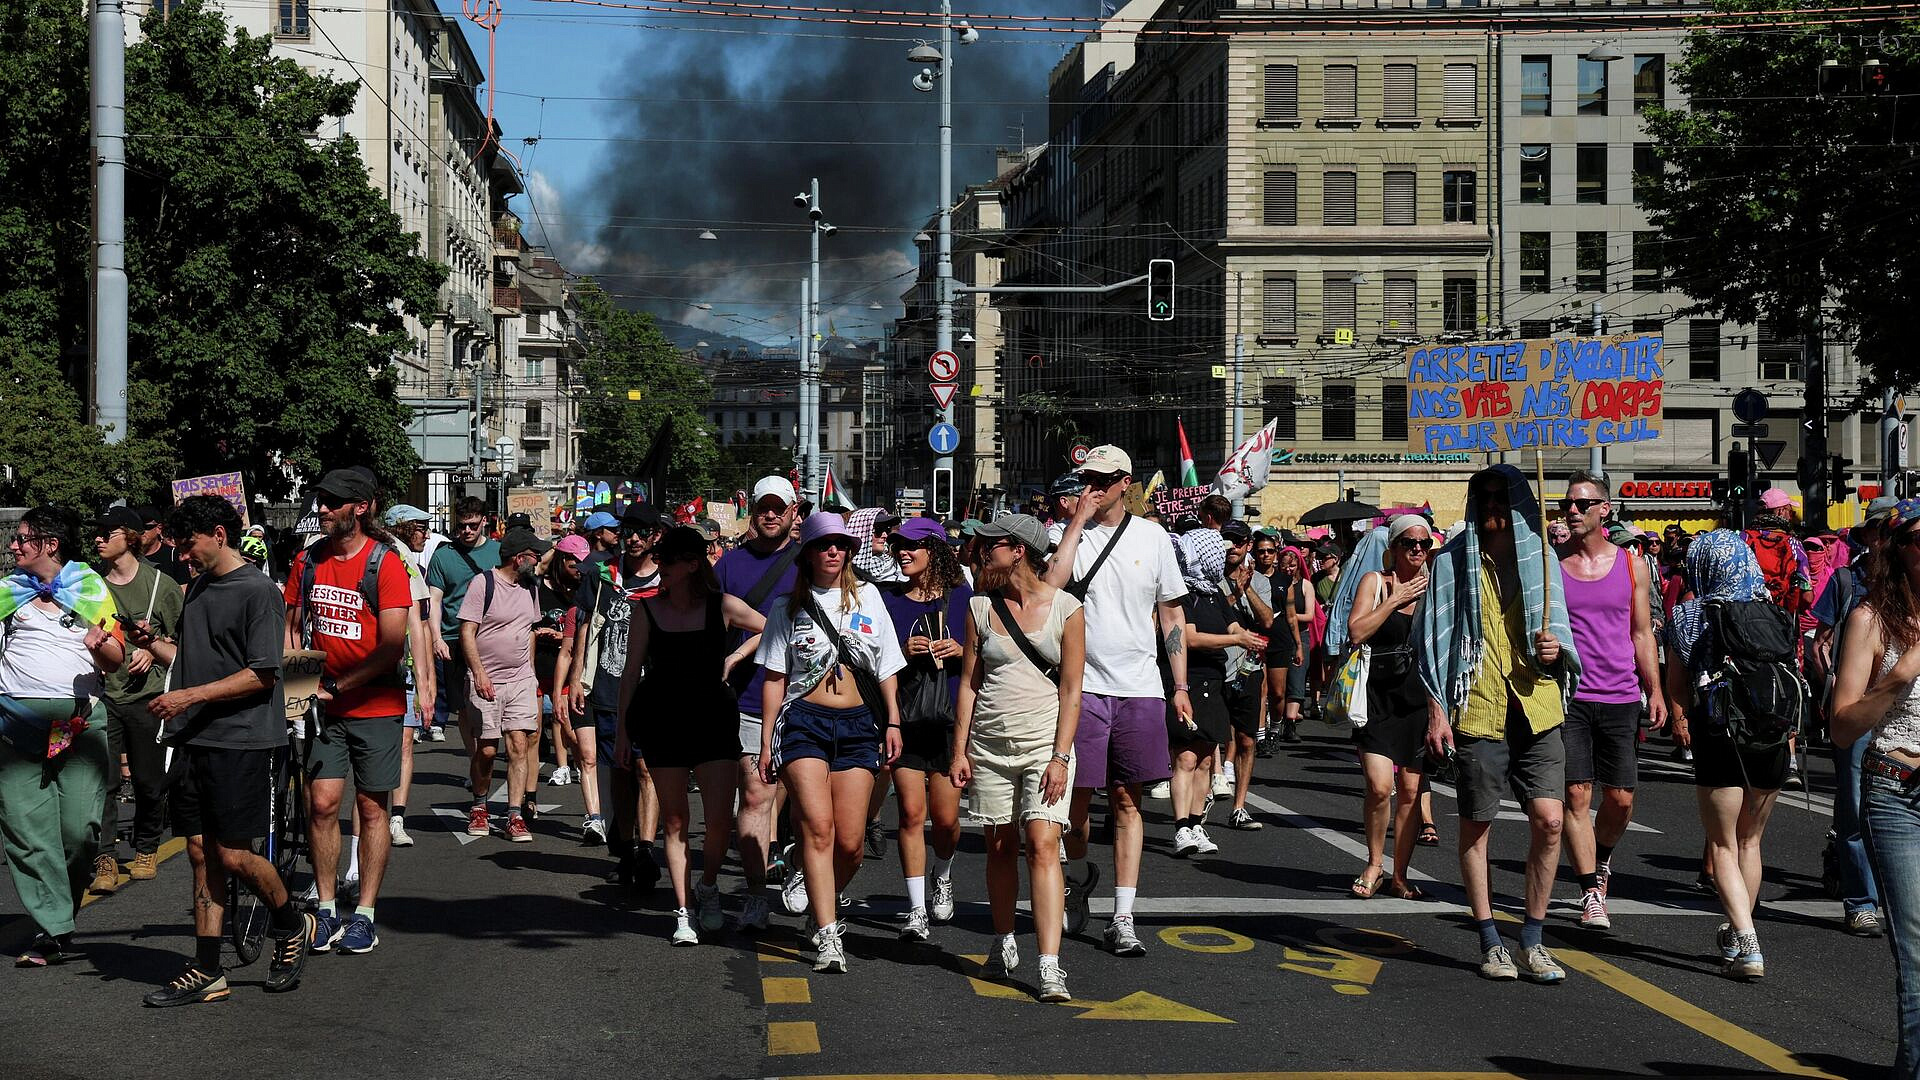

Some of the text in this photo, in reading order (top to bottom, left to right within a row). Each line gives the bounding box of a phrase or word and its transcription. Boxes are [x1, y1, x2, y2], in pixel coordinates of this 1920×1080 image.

[1408, 342, 1528, 383] ARRETEZ
[1408, 385, 1461, 419] NOS
[1519, 381, 1571, 418] NOS
[1571, 380, 1663, 422] CORPS
[1424, 418, 1659, 453] POUR VOTRE CUL
[1340, 453, 1402, 464] AGRICOLE
[172, 471, 241, 493] VOUS SEMEZ
[512, 496, 543, 508] STOP
[1154, 490, 1169, 504] JE
[1159, 499, 1185, 514] ETRE
